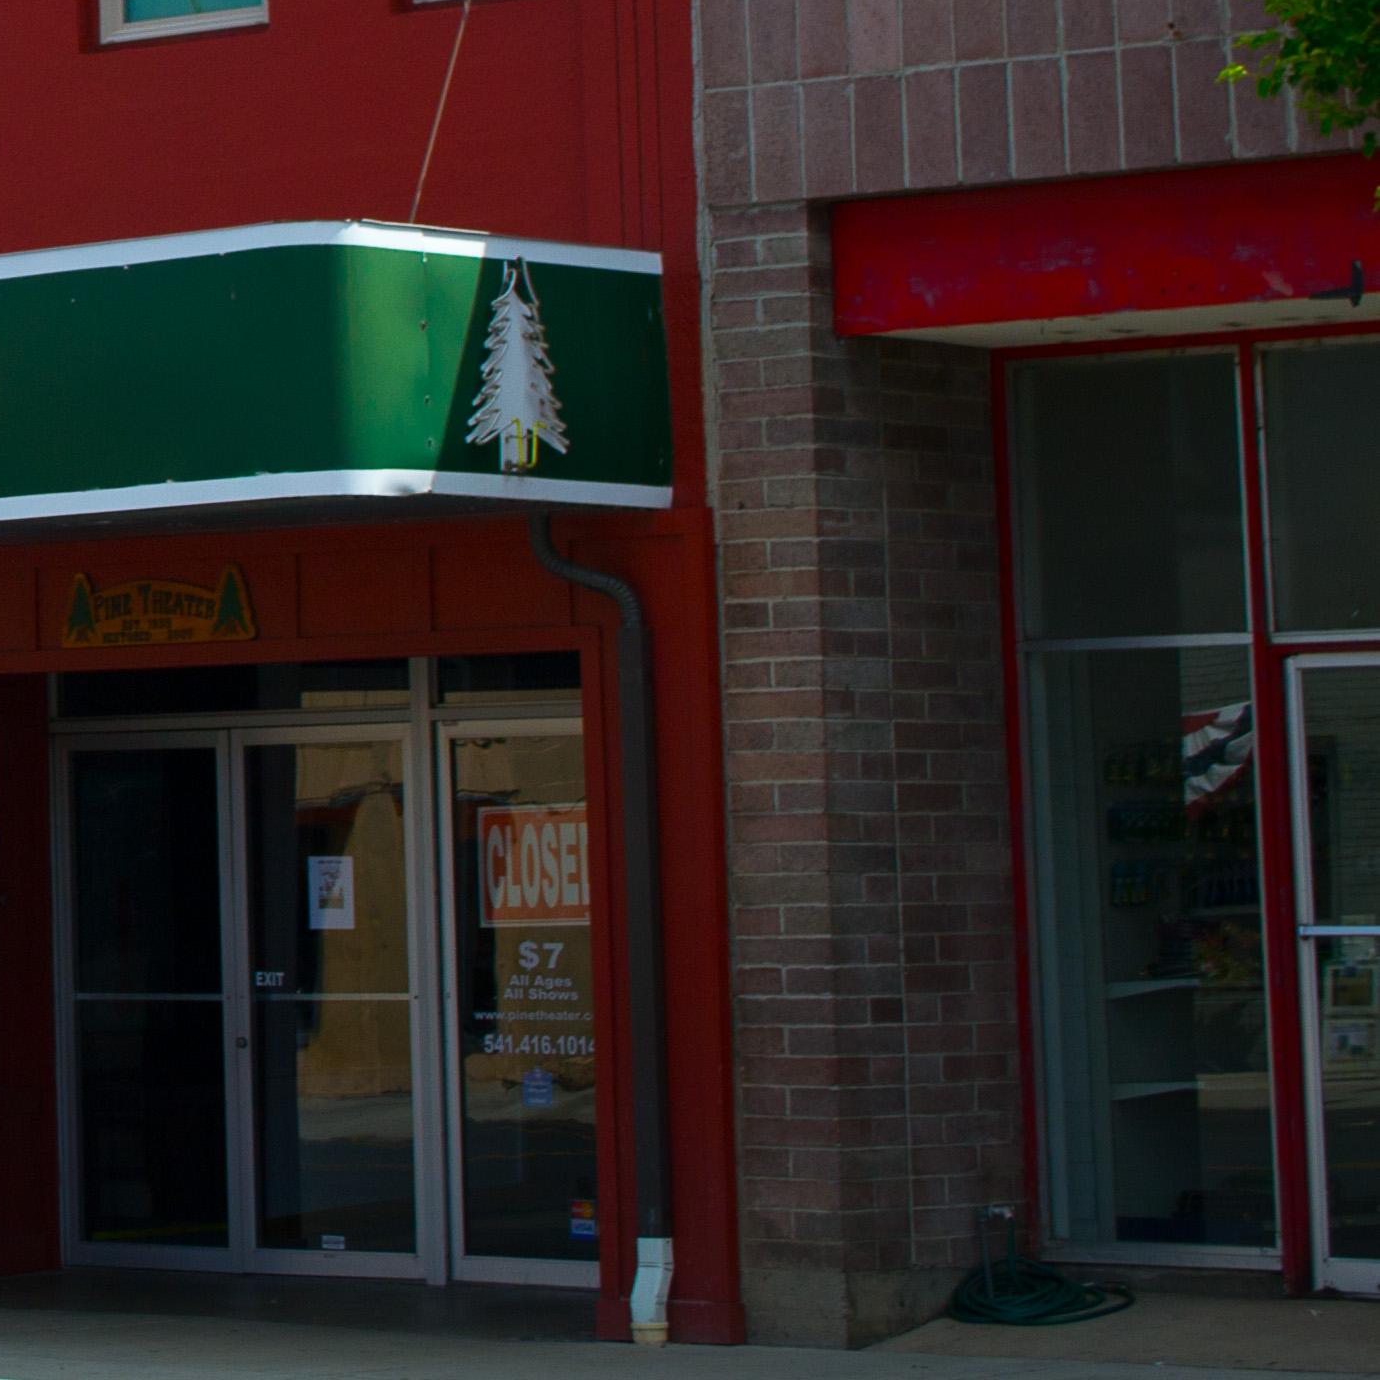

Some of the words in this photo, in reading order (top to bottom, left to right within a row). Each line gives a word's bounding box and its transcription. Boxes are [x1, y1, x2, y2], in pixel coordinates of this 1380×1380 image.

[518, 939, 565, 970] $7
[256, 971, 285, 987] EXIT
[509, 974, 529, 987] All
[534, 974, 573, 990] Ages
[503, 988, 524, 1001] All
[528, 988, 579, 1001] Shows
[473, 1010, 594, 1023] www.pinetheater.c
